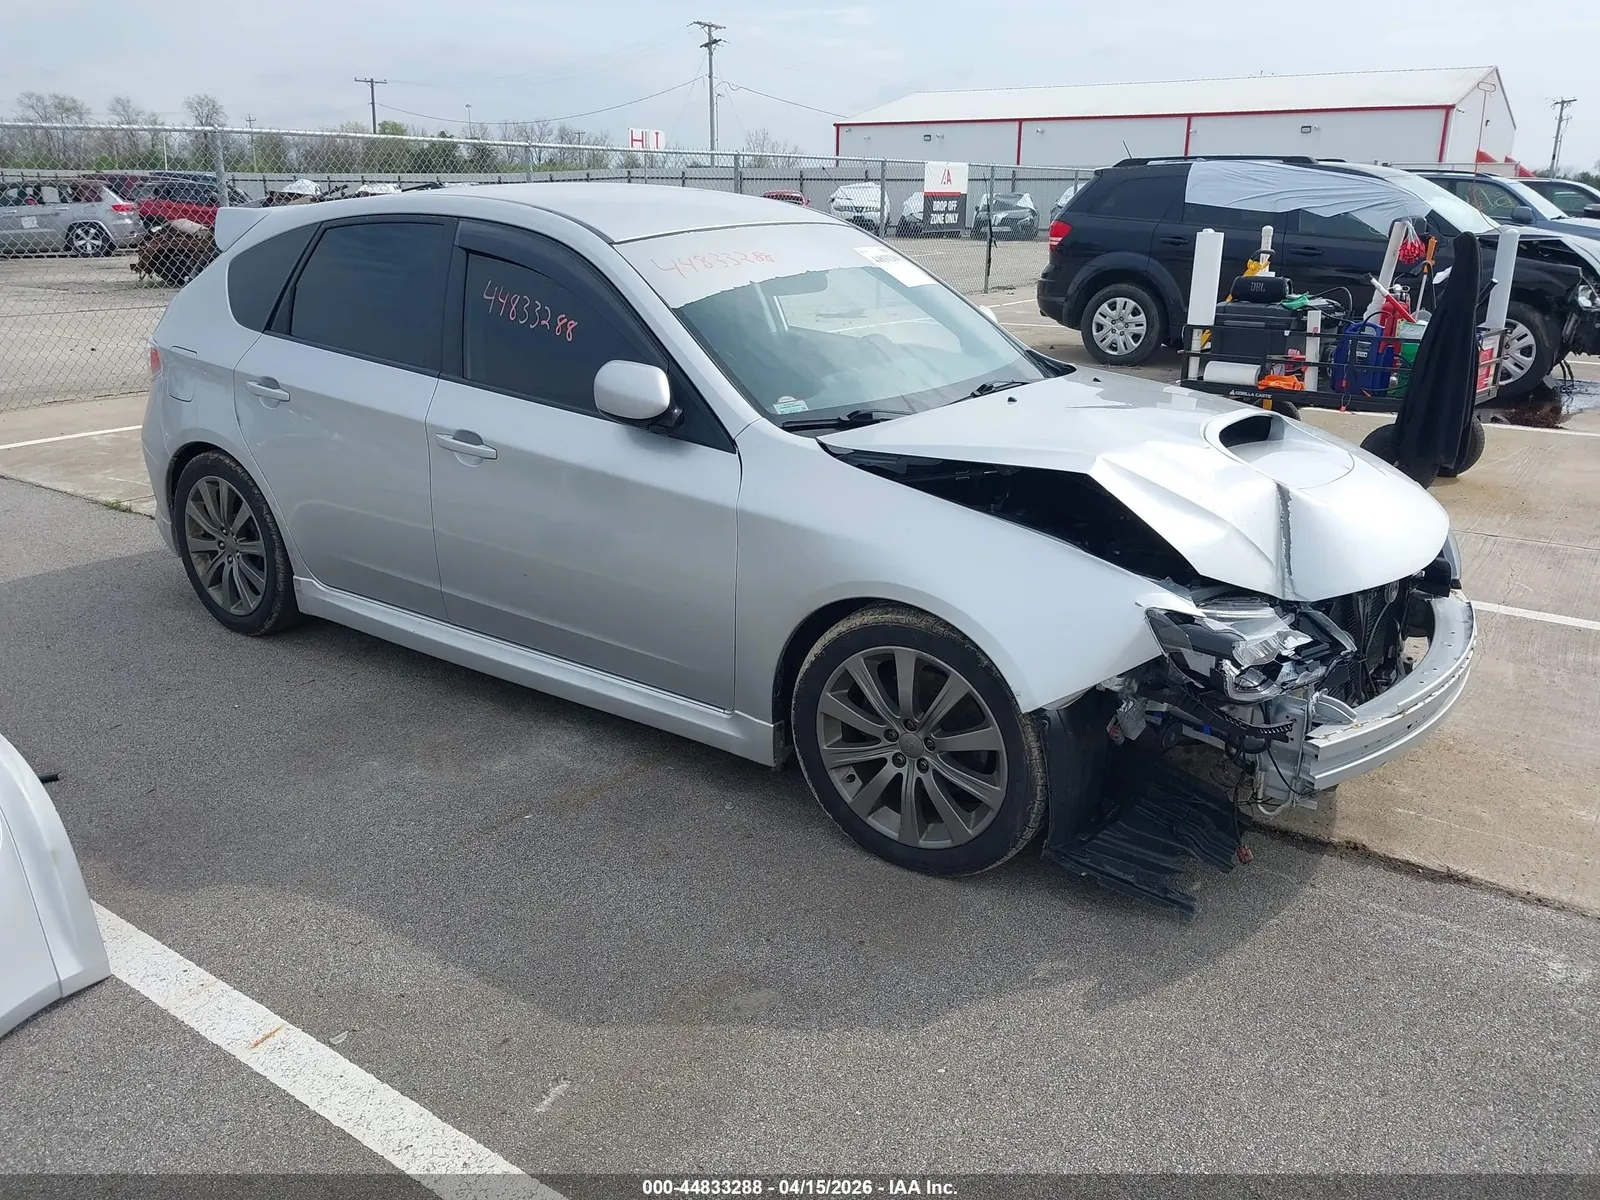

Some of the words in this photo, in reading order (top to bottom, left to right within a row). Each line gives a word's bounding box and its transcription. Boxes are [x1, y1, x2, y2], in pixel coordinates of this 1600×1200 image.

[932, 200, 948, 212] DROP
[948, 200, 958, 212] OFF
[930, 213, 945, 225] ZONE
[945, 213, 959, 224] ONLY
[650, 251, 776, 279] 44833288
[483, 279, 578, 342] 44833288
